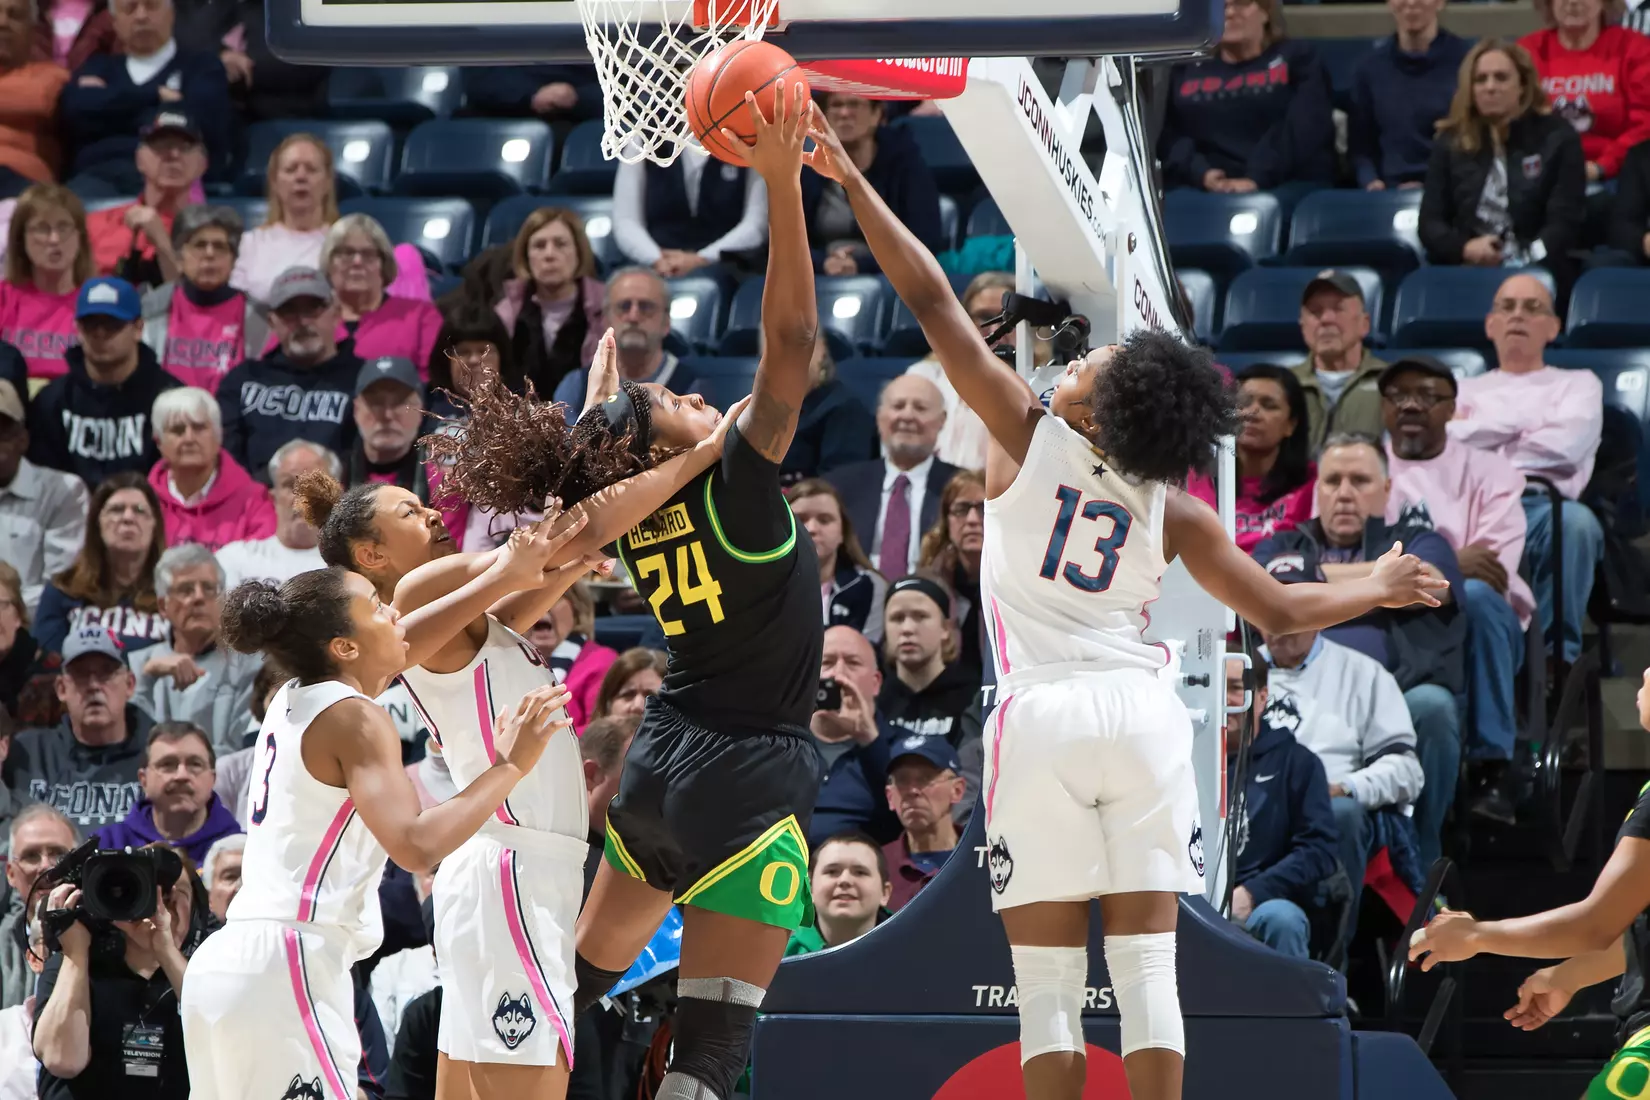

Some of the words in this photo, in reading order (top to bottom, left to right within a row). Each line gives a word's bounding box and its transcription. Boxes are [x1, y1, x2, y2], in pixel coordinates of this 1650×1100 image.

[1039, 484, 1133, 593] 13
[636, 540, 725, 636] 24
[251, 732, 277, 826] 3
[760, 861, 800, 905] O
[972, 985, 1112, 1009] TRARS
[123, 1049, 161, 1058] TELEVISION
